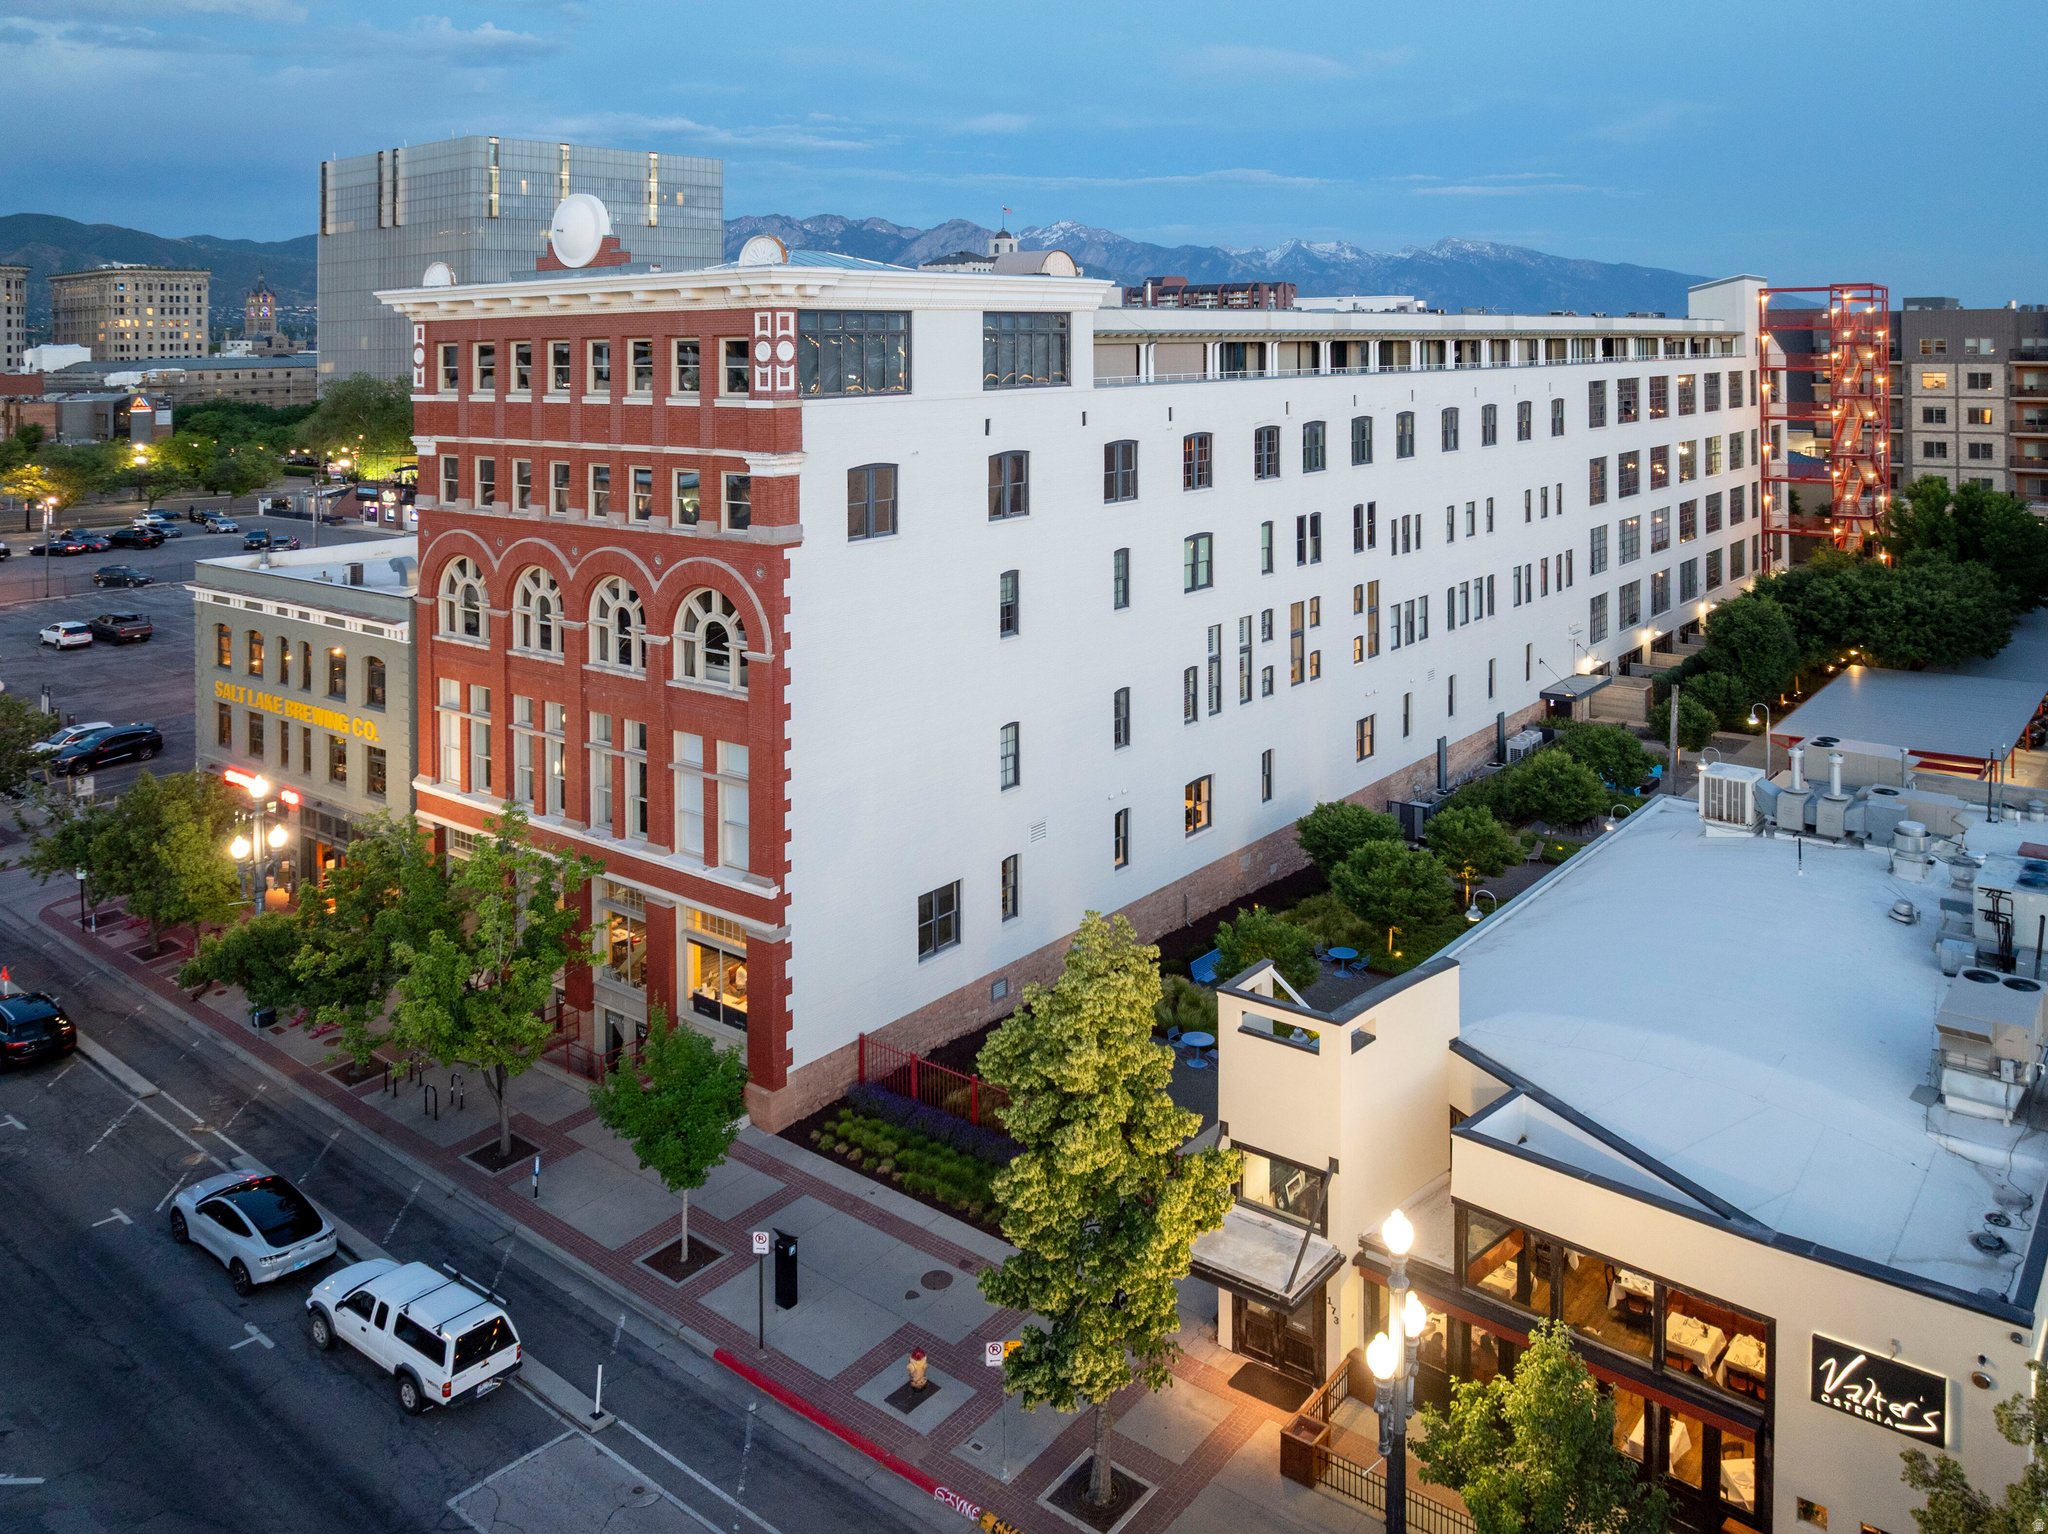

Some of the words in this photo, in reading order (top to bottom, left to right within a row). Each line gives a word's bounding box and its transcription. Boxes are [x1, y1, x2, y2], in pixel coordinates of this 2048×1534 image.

[214, 680, 246, 704] SALT
[247, 689, 283, 715] LAKE
[284, 700, 350, 734] BREWING
[352, 717, 380, 742] CO.
[1327, 1297, 1339, 1325] 173
[1819, 1354, 1942, 1433] Valter's
[1820, 1393, 1894, 1428] OSTERIA
